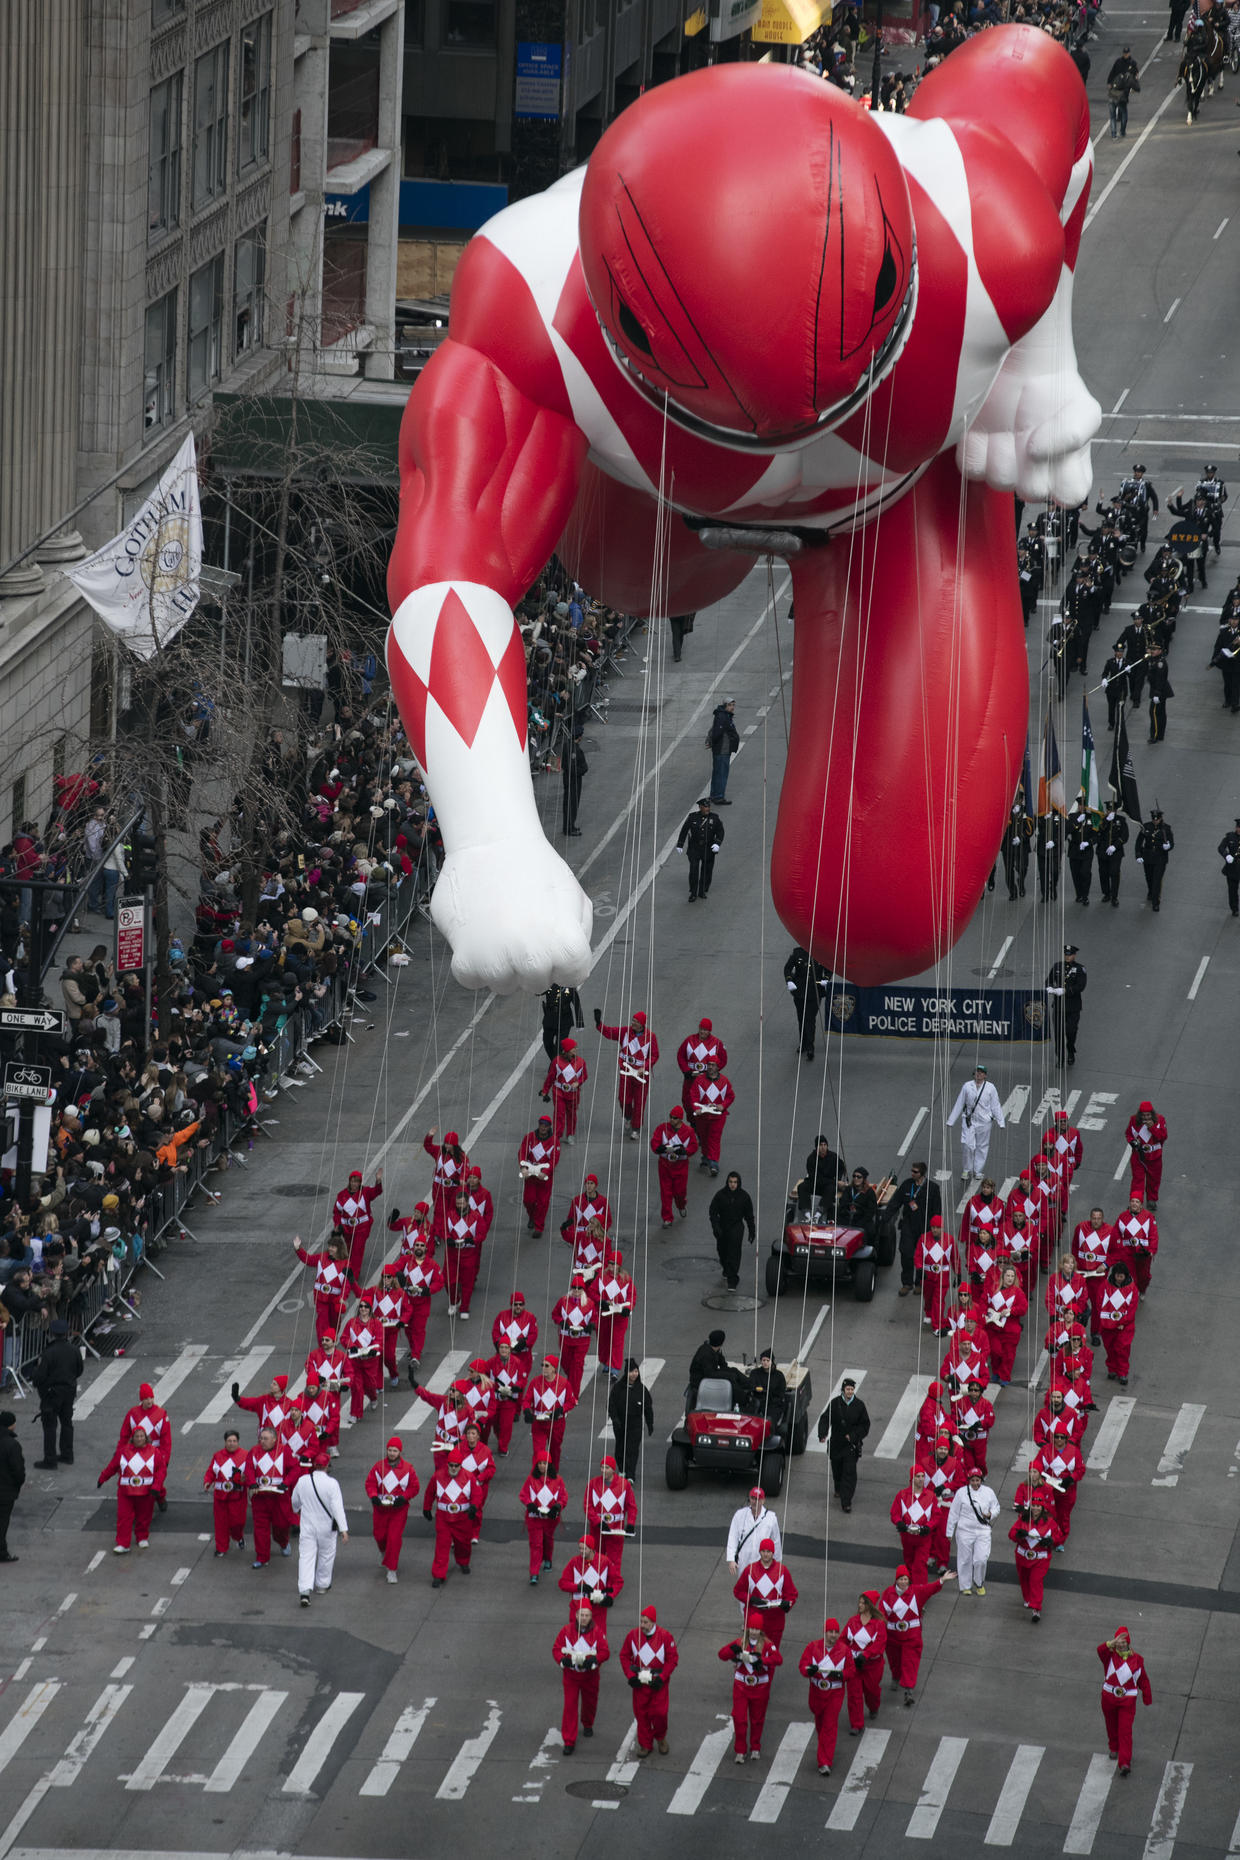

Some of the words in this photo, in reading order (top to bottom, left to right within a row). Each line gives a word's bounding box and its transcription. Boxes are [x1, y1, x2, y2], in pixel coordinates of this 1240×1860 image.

[115, 491, 187, 577] GOTHAM
[884, 996, 915, 1012] NEW
[921, 998, 957, 1013] YORK
[963, 999, 993, 1015] CITY
[6, 1014, 26, 1023] ONE
[34, 1016, 53, 1025] WAY
[868, 1015, 917, 1032] POLICE
[922, 1018, 1011, 1036] DEPARTMENT
[6, 1084, 23, 1093] BIKE
[26, 1087, 46, 1096] LANE
